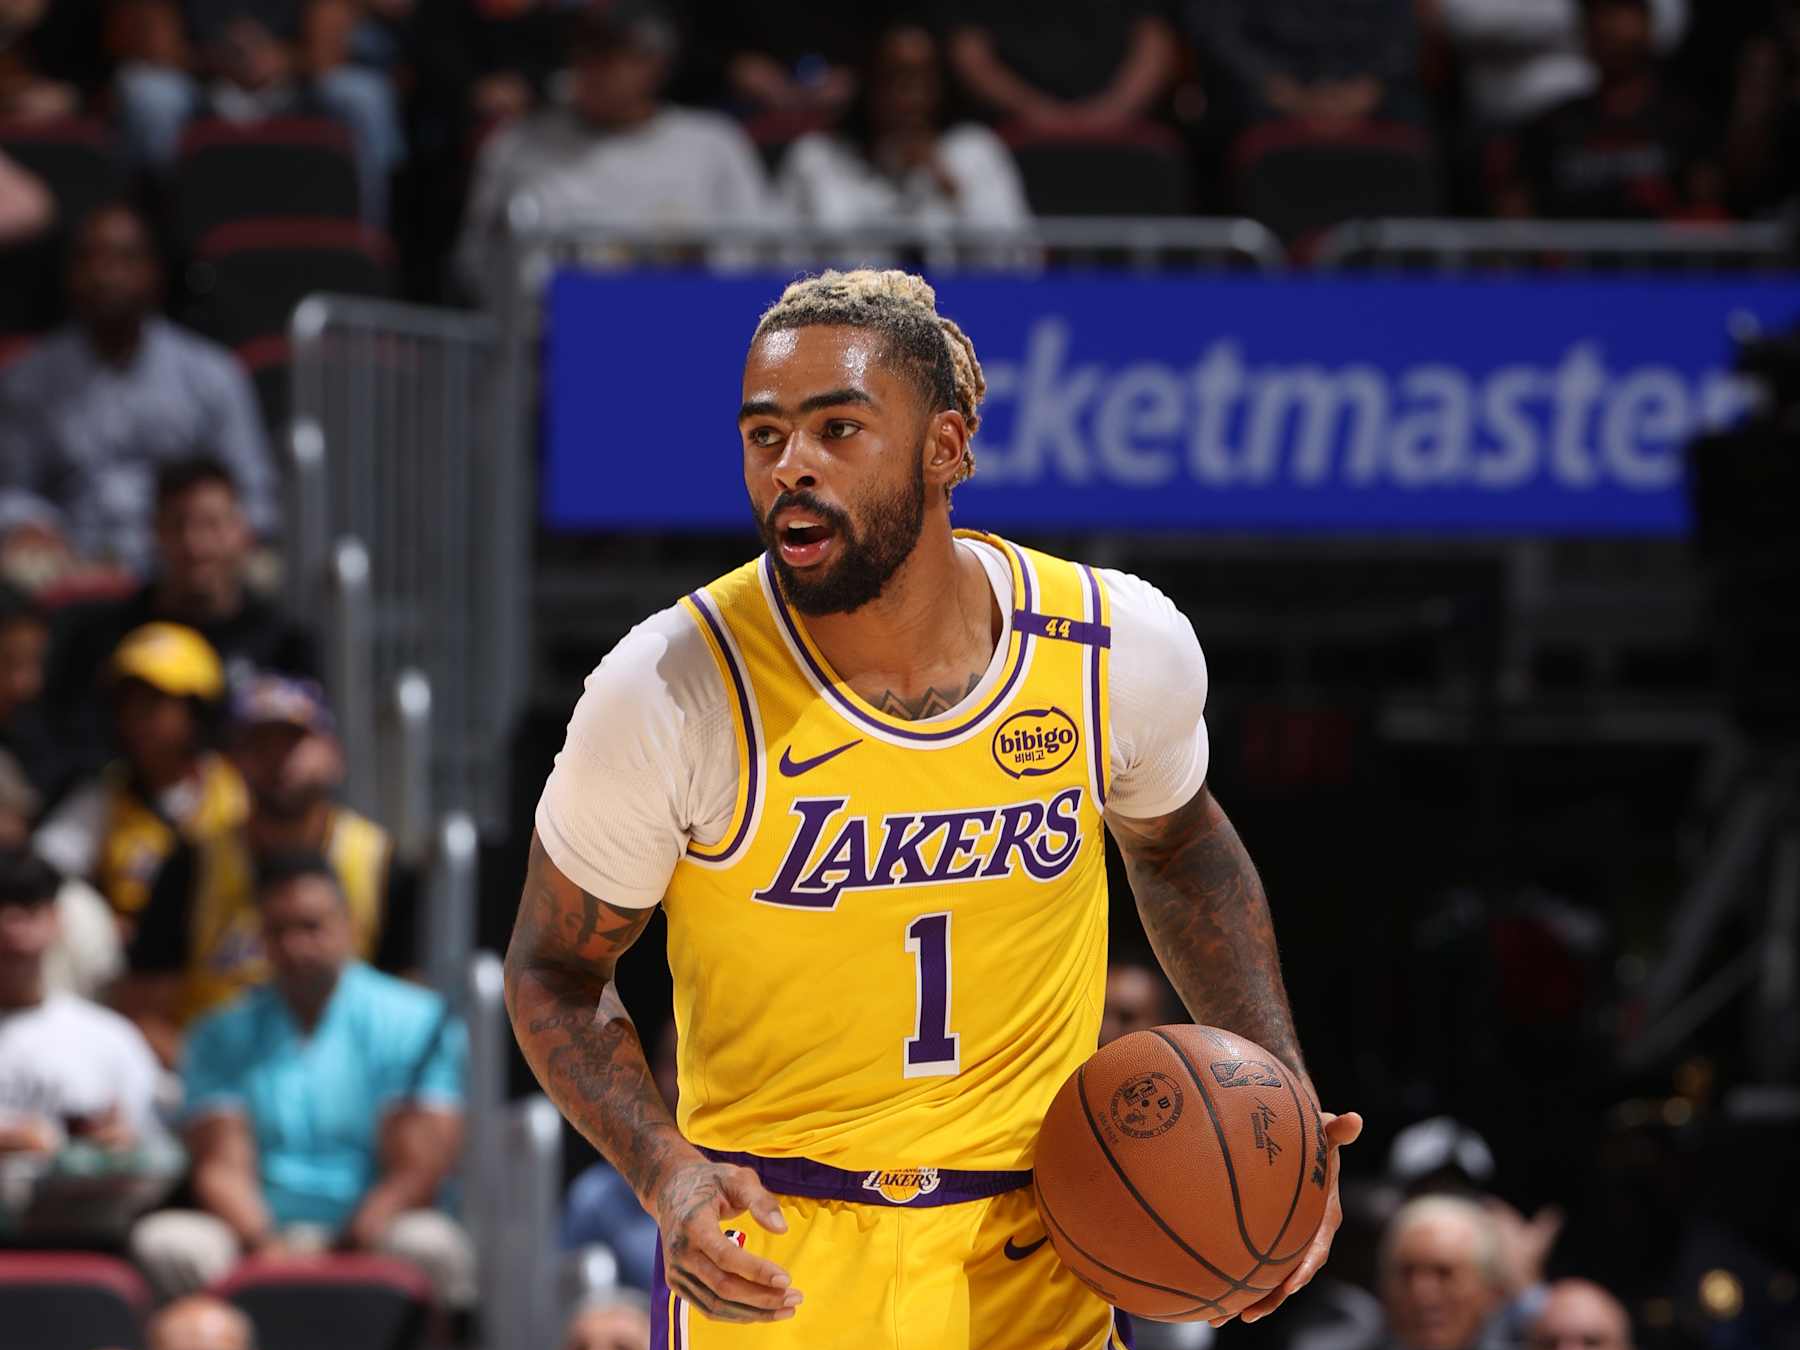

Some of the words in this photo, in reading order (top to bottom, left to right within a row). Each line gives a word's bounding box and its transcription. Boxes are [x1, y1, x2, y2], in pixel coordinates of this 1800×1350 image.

[1045, 618, 1071, 638] 44
[1000, 726, 1073, 754] bibigo
[1014, 749, 1045, 764] 비비고
[752, 786, 1083, 911] LAKERS
[904, 911, 960, 1079] 1
[863, 1169, 940, 1192] LAKERS
